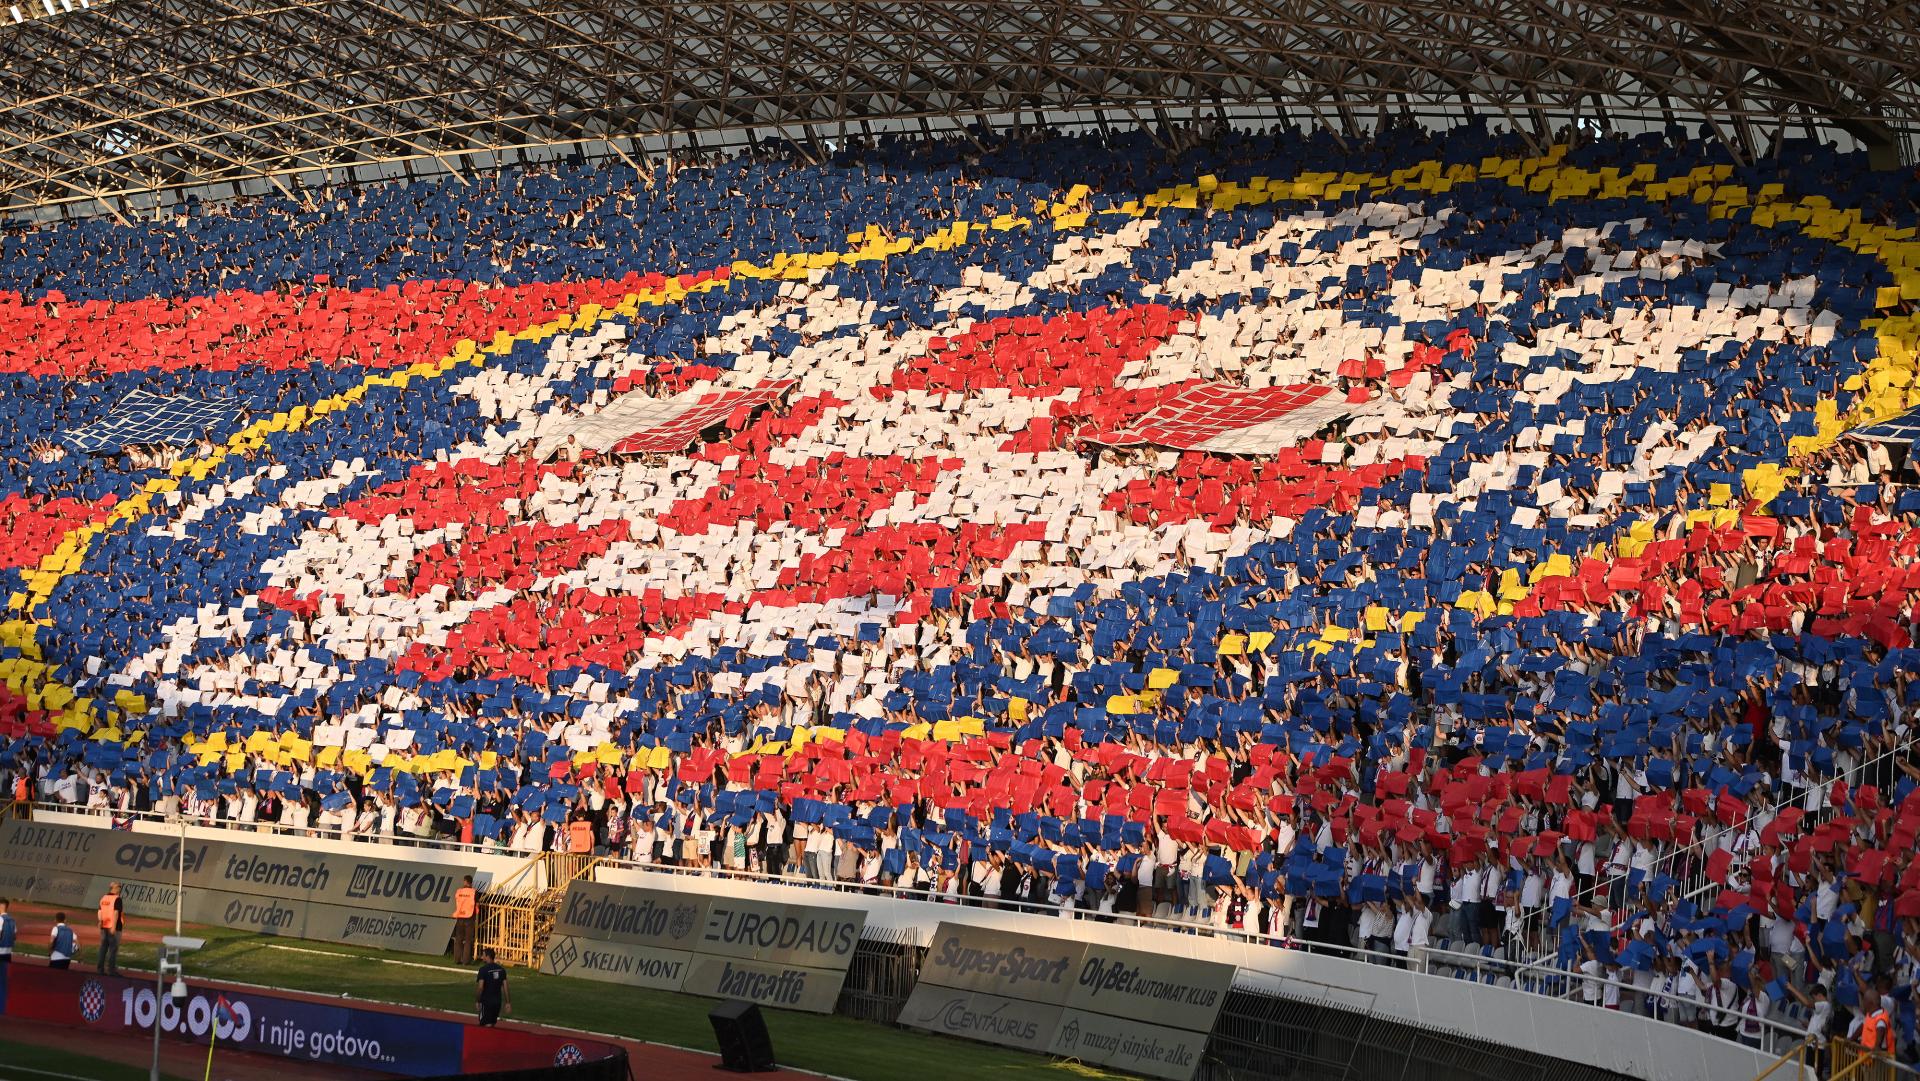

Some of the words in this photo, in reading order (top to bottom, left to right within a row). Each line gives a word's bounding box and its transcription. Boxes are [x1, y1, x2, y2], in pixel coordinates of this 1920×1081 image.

[9, 825, 96, 853] ADRIATIC
[114, 841, 209, 873] apfel
[224, 853, 330, 891] telemach
[371, 869, 454, 903] LUKOIL
[240, 900, 294, 929] rudan
[564, 891, 669, 937] Karlovačko
[705, 909, 855, 955] EURODAUS
[581, 950, 634, 976] SKELIN
[635, 957, 683, 980] MONT
[935, 937, 1069, 985] SuperSport
[717, 961, 807, 1005] barcaffé
[1079, 956, 1140, 996] OlyBet
[1132, 979, 1187, 1002] AUTOMAT
[1187, 986, 1219, 1008] KLUB
[260, 1016, 265, 1043] i
[271, 1020, 305, 1055] nije
[310, 1030, 396, 1062] gotovo...
[1083, 1031, 1117, 1057] muzej
[1119, 1035, 1165, 1061] sinjske
[1164, 1043, 1193, 1067] alke
